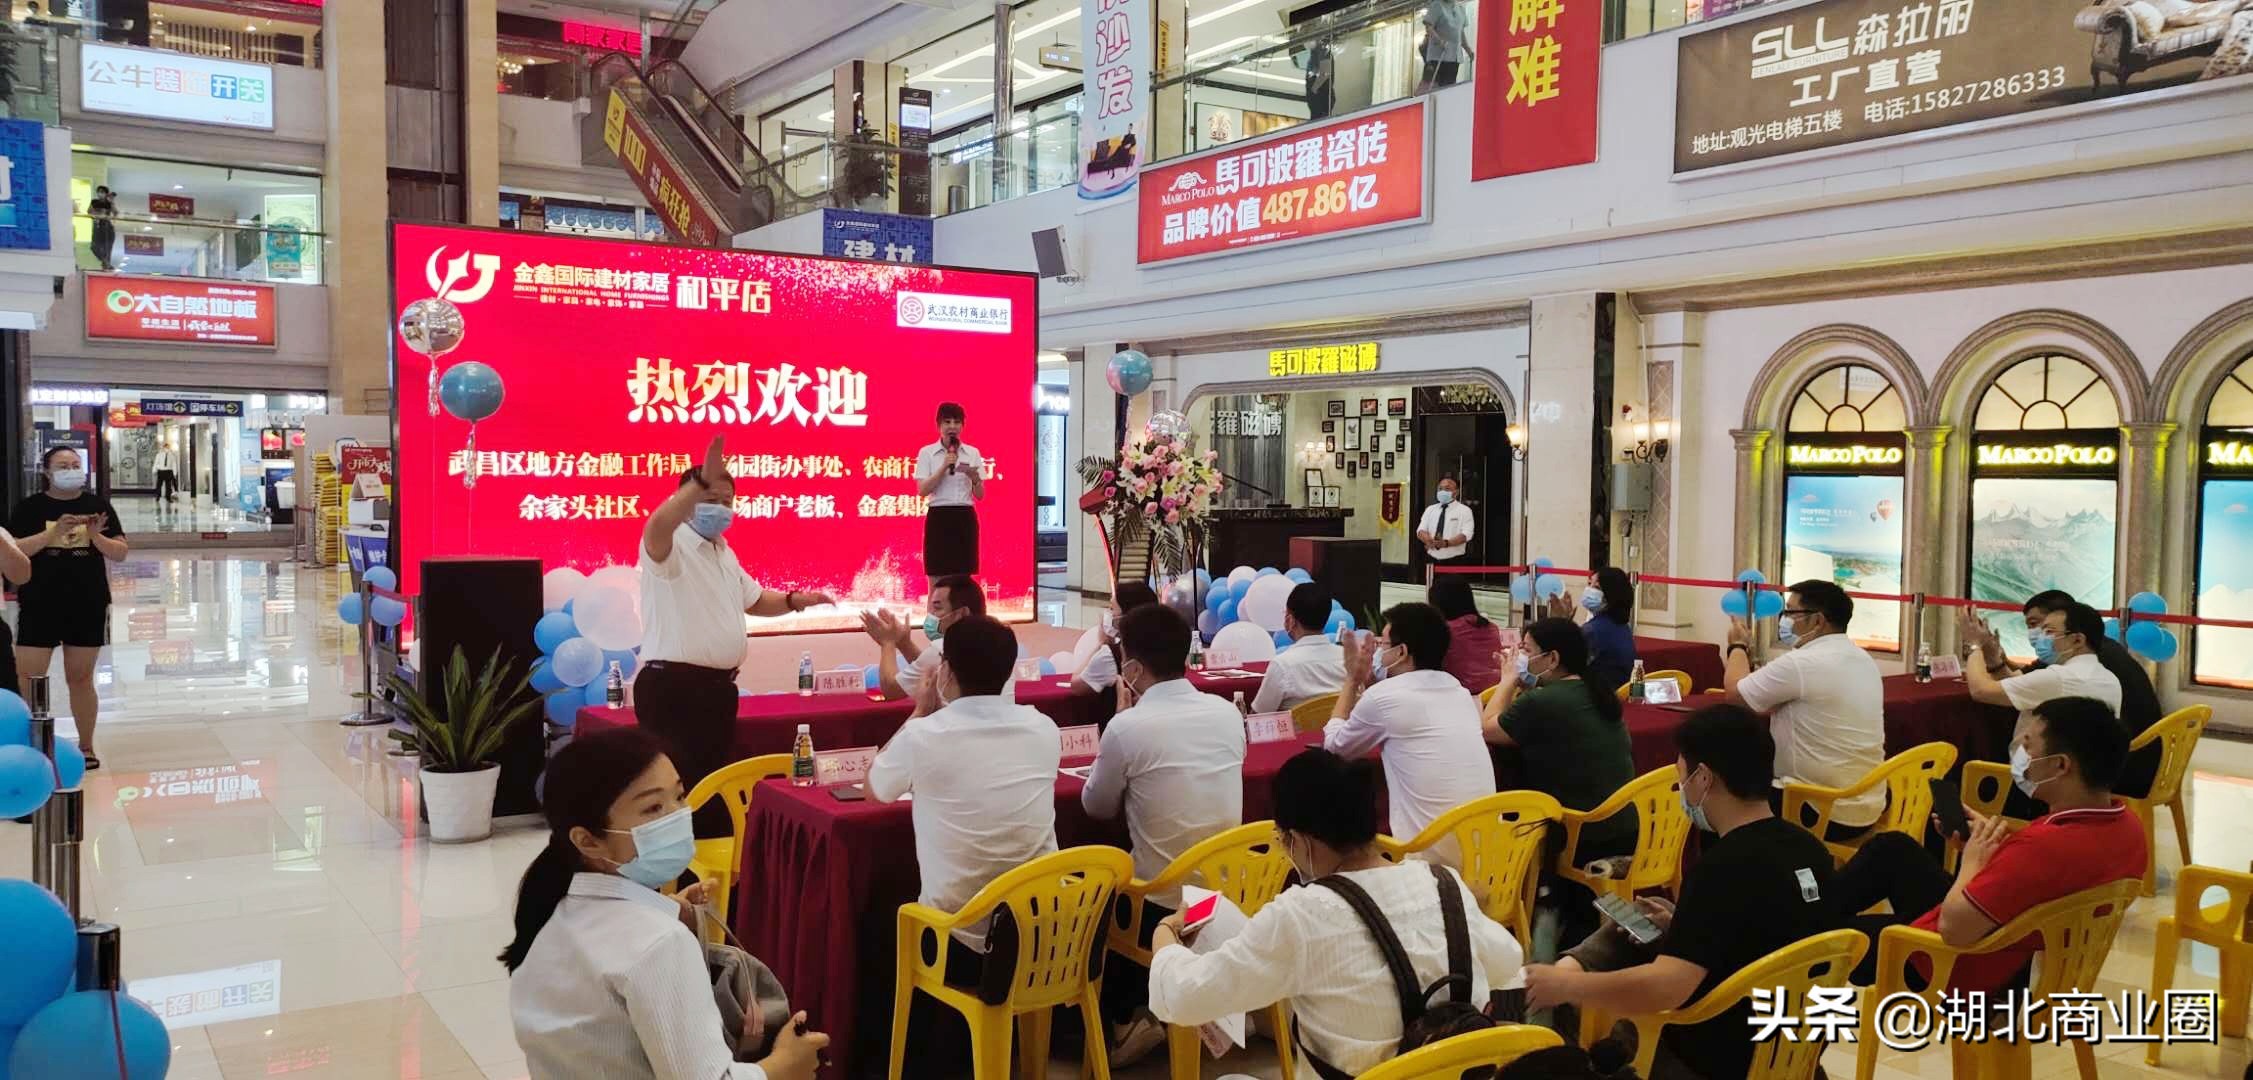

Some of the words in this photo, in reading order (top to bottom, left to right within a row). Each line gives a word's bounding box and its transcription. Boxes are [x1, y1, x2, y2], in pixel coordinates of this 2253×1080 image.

[1751, 17, 1849, 67] SLL
[1853, 0, 1974, 56] 森拉丽
[87, 60, 265, 103] 公牛装饰开关
[1790, 50, 1941, 107] 工厂直营
[1692, 108, 1843, 156] 地址:观光电梯五楼
[1864, 66, 2065, 124] 电话:15827286333
[1161, 192, 1192, 207] MARCO
[1192, 185, 1216, 201] POLO
[1163, 174, 1378, 246] 品牌价值487.86亿
[843, 240, 916, 263] 建材
[513, 262, 670, 293] 金鑫国际建材家居
[676, 275, 772, 314] 和平店
[541, 286, 598, 297] INTERNATIONAL
[134, 293, 257, 319] 大自然地板
[927, 303, 1009, 321] 武汉农村商业银行
[1269, 342, 1378, 377] 馬可波羅磁磚
[627, 356, 868, 428] 热烈欢迎
[1210, 409, 1283, 437] 羅磁磚
[1789, 444, 1851, 465] MARCO
[1851, 444, 1904, 465] POLO
[1977, 444, 2054, 465] MARCO
[2054, 444, 2117, 465] POLO
[1060, 733, 1093, 752] 小科
